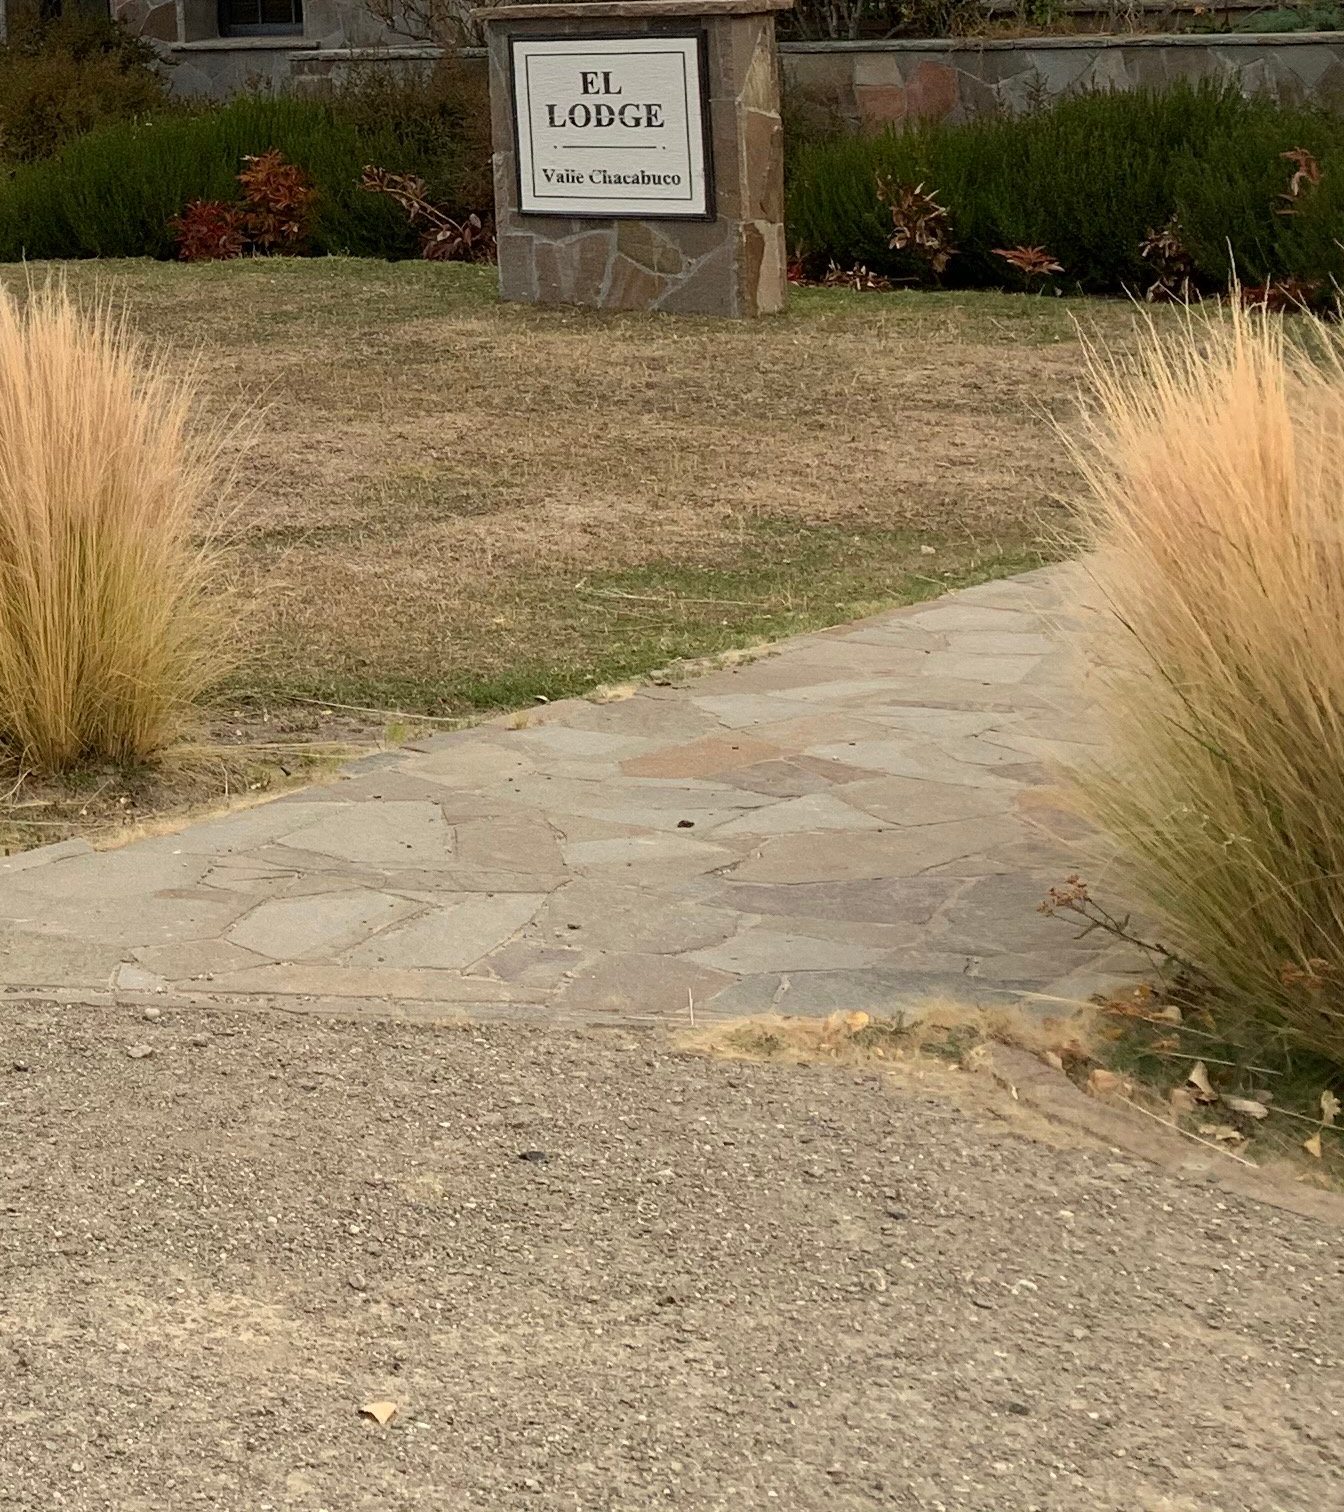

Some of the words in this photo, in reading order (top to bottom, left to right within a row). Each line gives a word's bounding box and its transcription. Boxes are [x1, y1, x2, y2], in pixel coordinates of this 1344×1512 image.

[579, 70, 622, 95] EL
[545, 103, 665, 128] LODGE
[542, 168, 585, 185] Valle
[589, 169, 682, 186] Chacabuco
